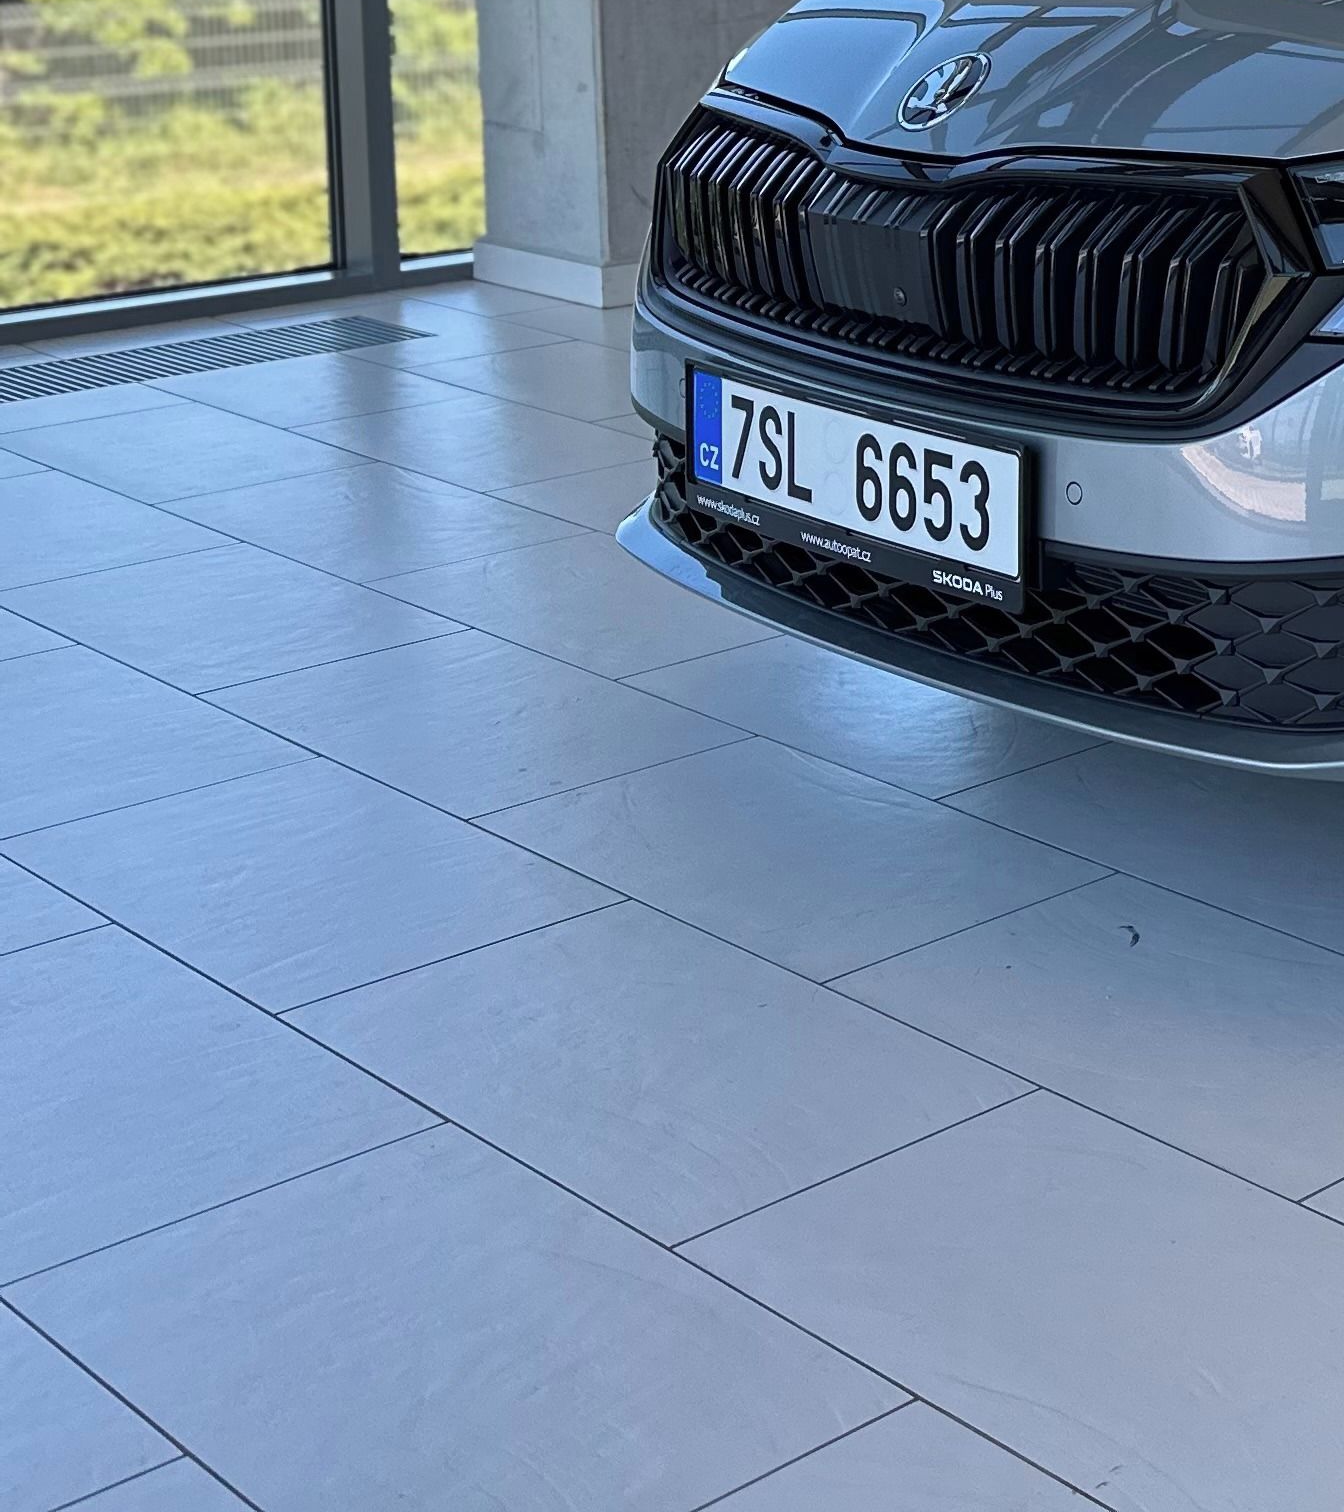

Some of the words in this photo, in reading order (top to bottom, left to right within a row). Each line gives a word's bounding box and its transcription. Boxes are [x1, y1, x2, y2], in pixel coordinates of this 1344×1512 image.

[699, 442, 720, 471] CZ
[730, 393, 813, 505] 7SL
[854, 432, 991, 552] 6653
[696, 494, 761, 527] www.skodaplus.cz
[800, 531, 872, 563] www.autoopat.cz
[985, 584, 1003, 601] Plus
